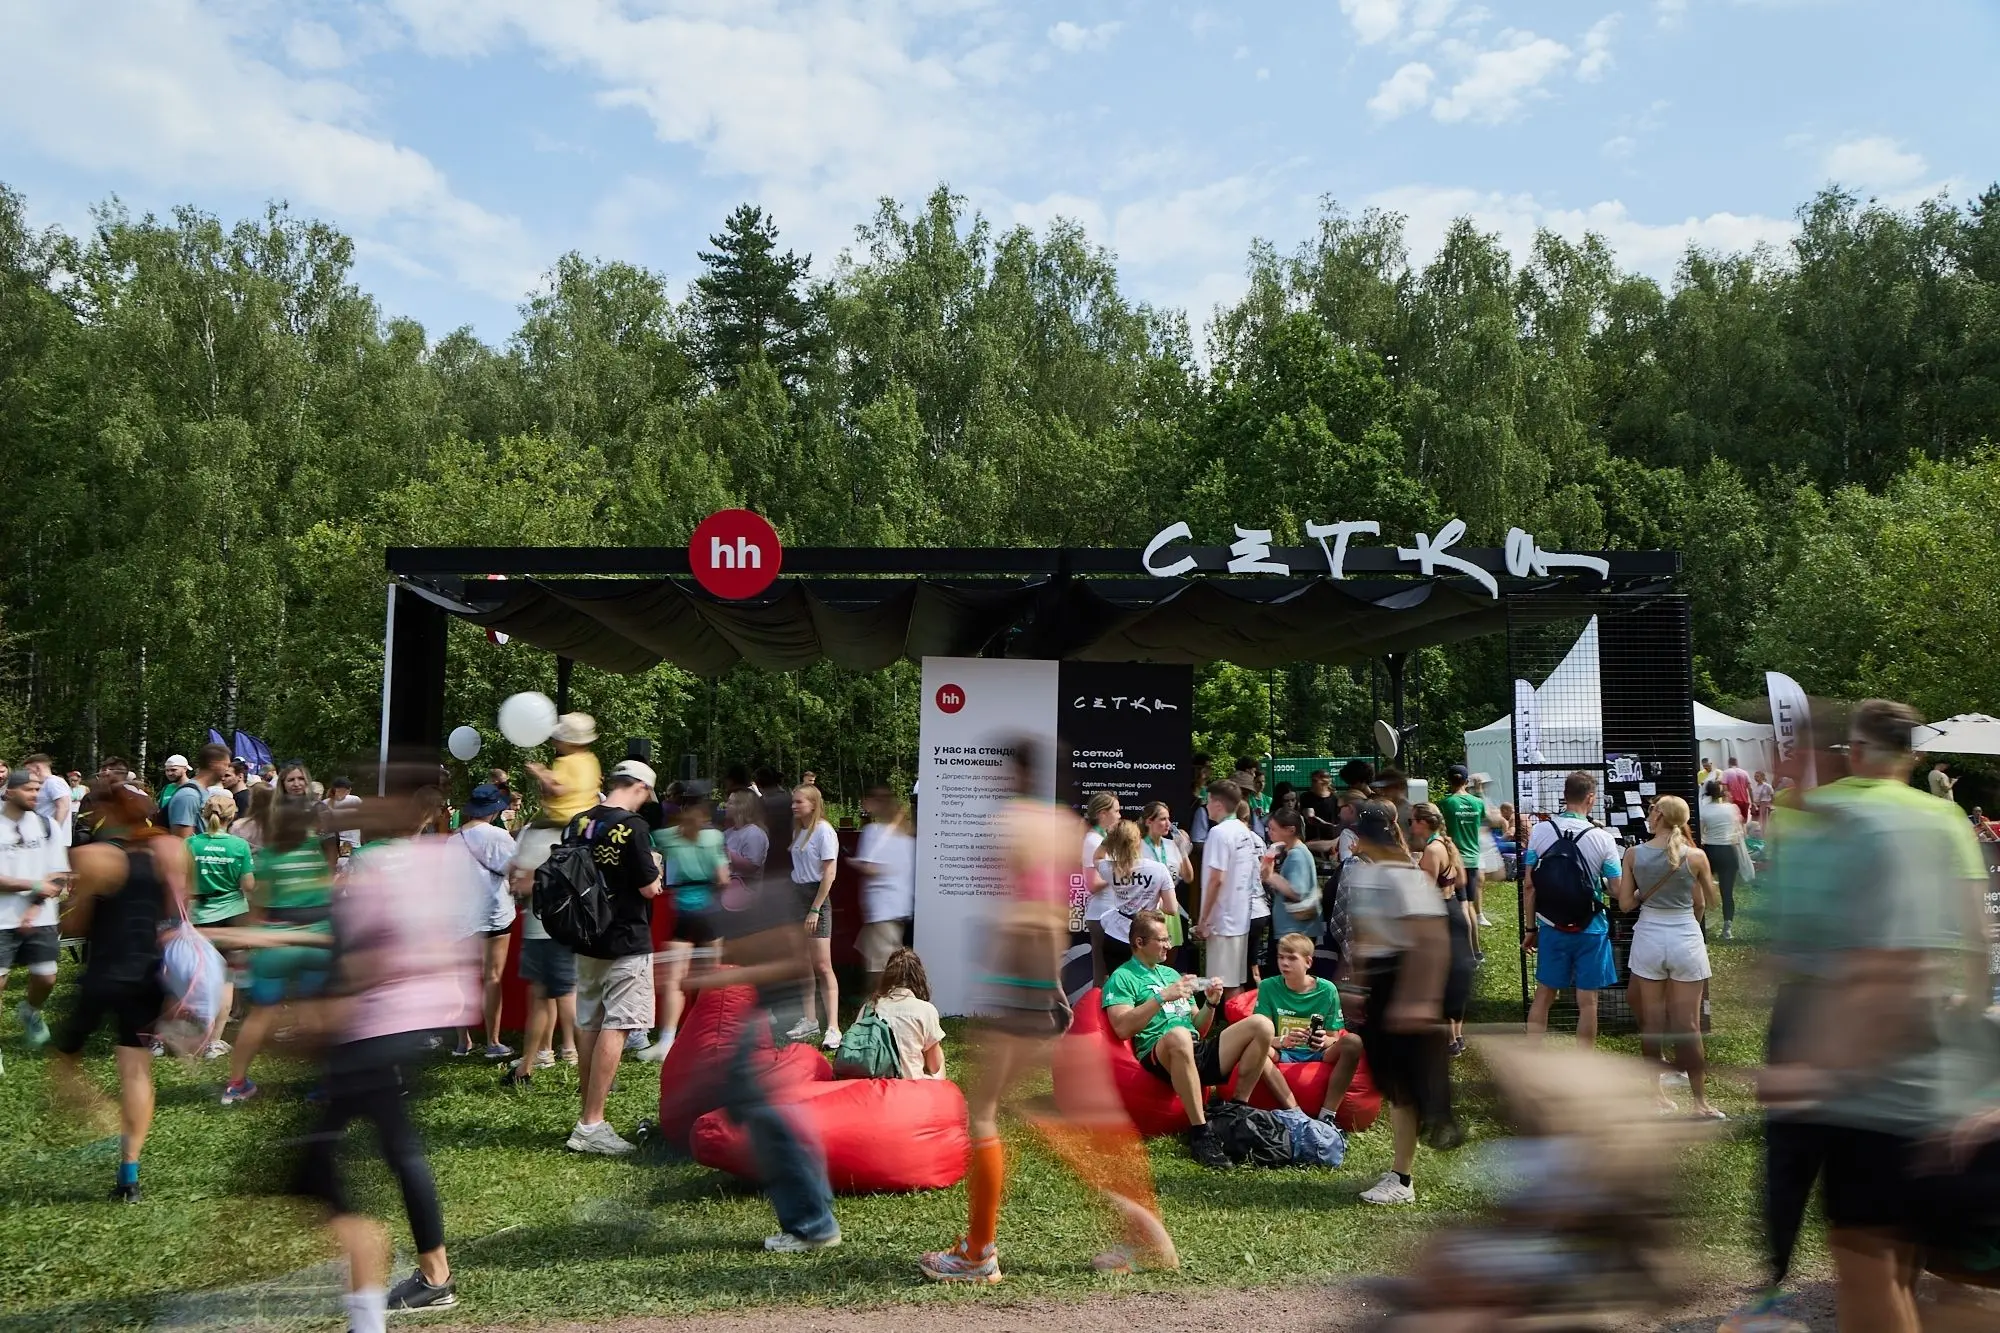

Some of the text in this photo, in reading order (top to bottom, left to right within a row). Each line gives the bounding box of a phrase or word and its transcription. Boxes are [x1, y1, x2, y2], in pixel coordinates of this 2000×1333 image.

[711, 536, 760, 568] hh
[942, 692, 959, 704] hh
[934, 746, 940, 755] у
[1082, 749, 1123, 757] сеткой
[950, 758, 1003, 766] сможешь:
[1089, 761, 1132, 769] стенде
[1113, 872, 1152, 888] Lofty
